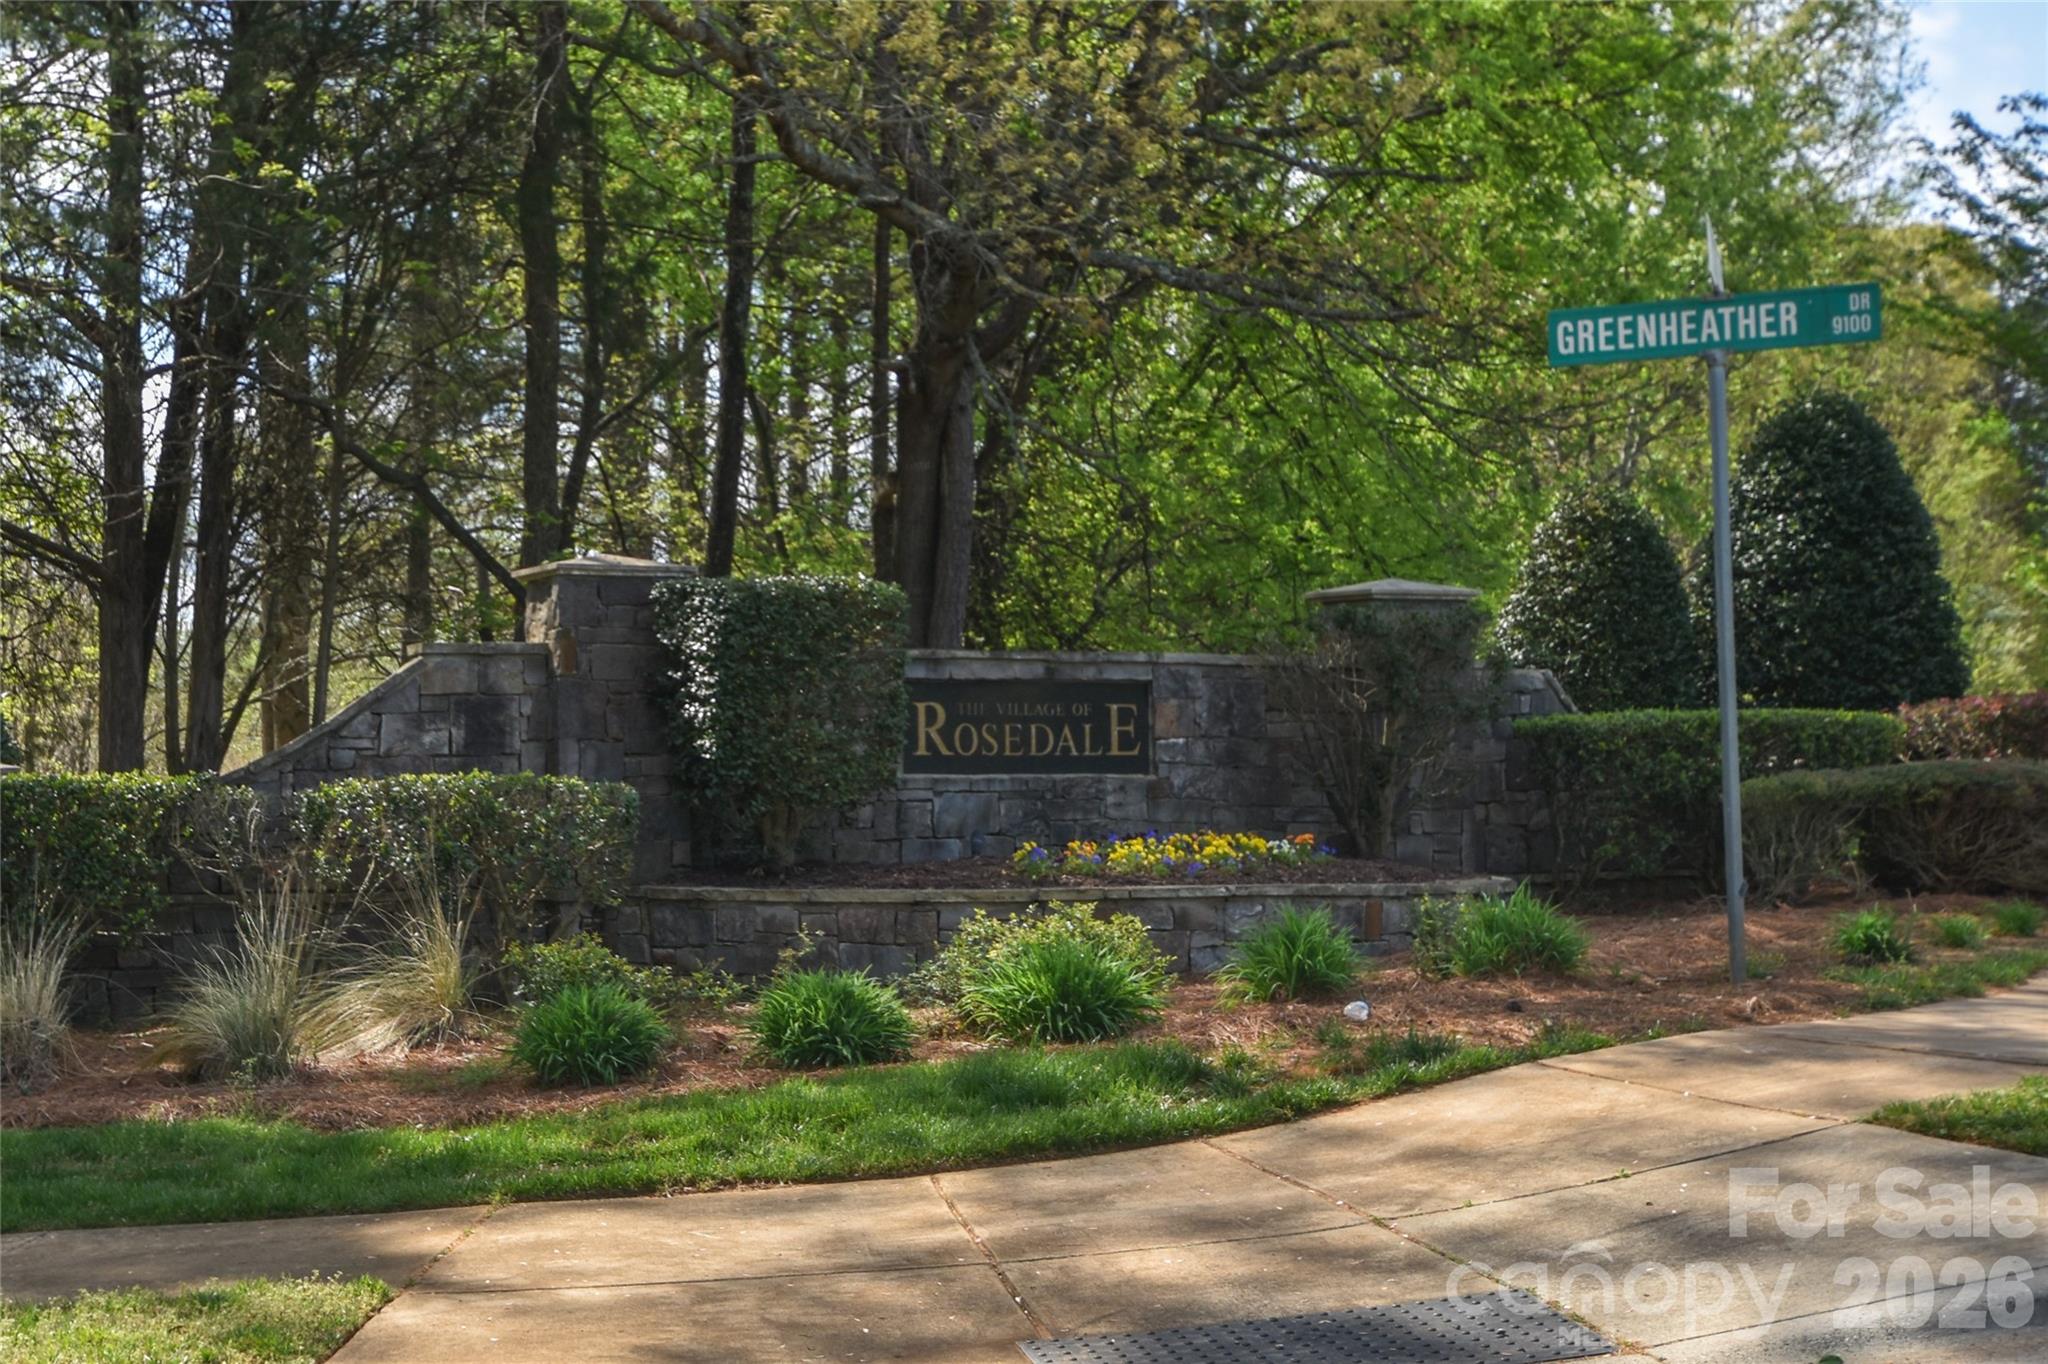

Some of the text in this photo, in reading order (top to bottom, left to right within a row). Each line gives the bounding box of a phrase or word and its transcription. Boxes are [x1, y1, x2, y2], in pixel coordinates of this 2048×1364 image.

[1849, 292, 1871, 312] DR
[1556, 301, 1798, 355] GREENHEATHER
[1831, 314, 1872, 335] 9100
[996, 702, 1066, 717] VILLAGE
[1071, 702, 1092, 716] OF
[912, 701, 1141, 756] ROSEDALE
